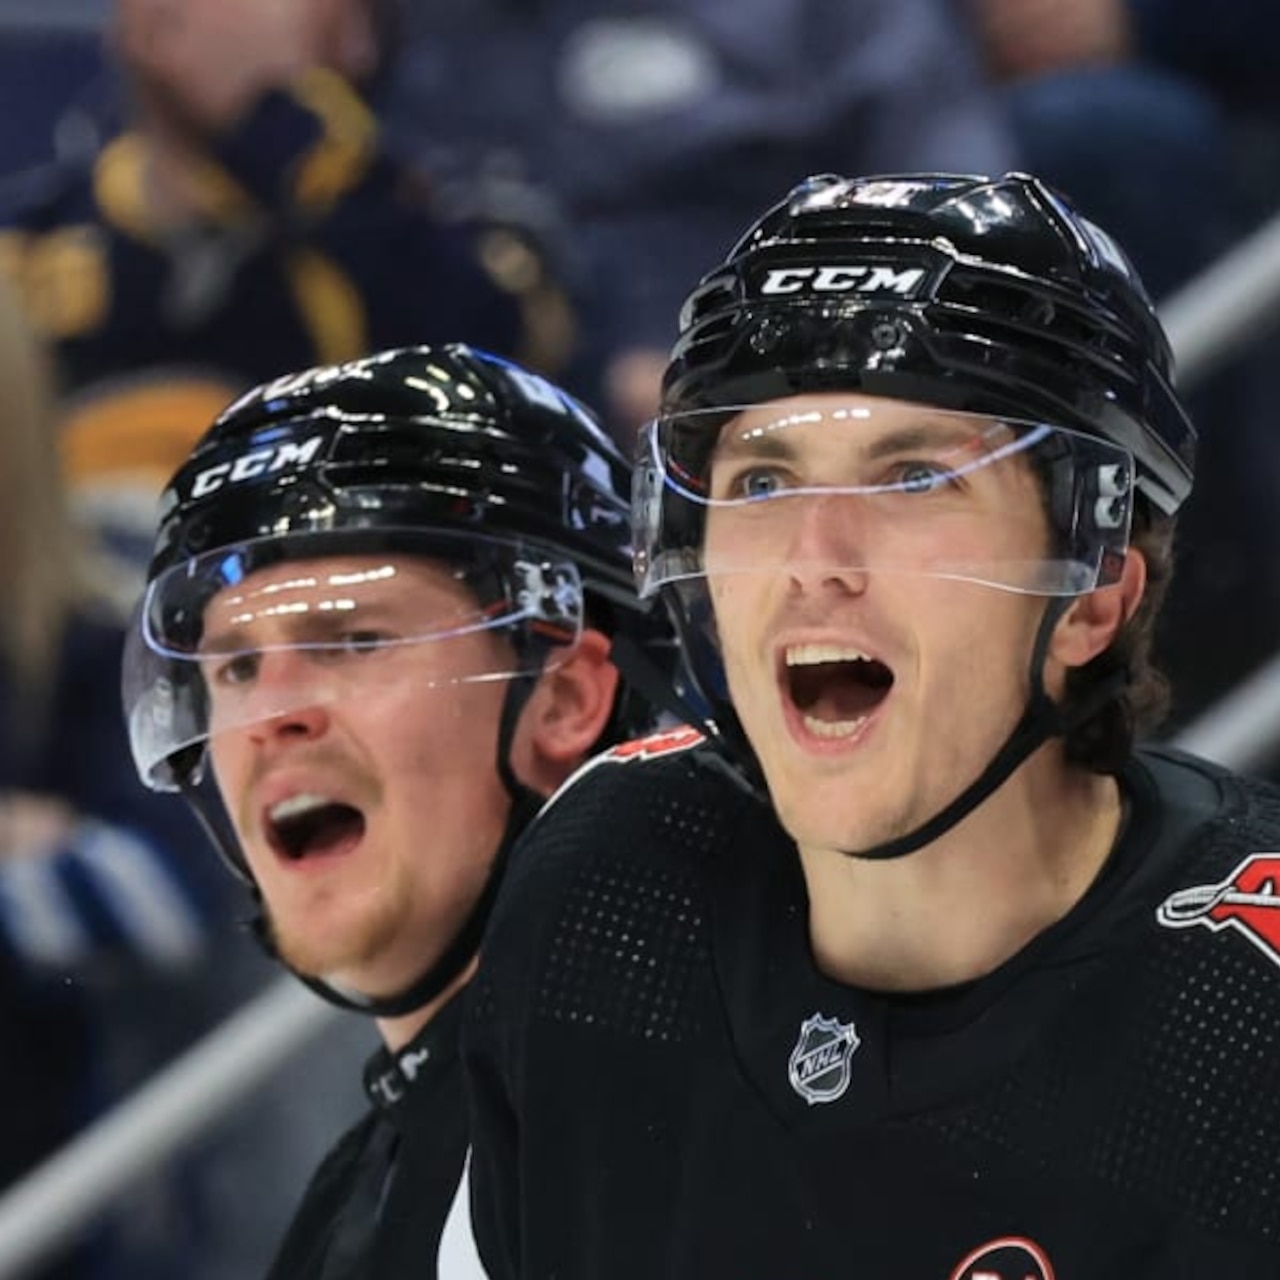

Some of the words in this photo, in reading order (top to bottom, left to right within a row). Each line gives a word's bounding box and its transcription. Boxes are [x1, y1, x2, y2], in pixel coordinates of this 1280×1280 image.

[761, 265, 925, 295] CCM
[190, 436, 322, 500] CCM
[800, 1041, 842, 1079] NHL
